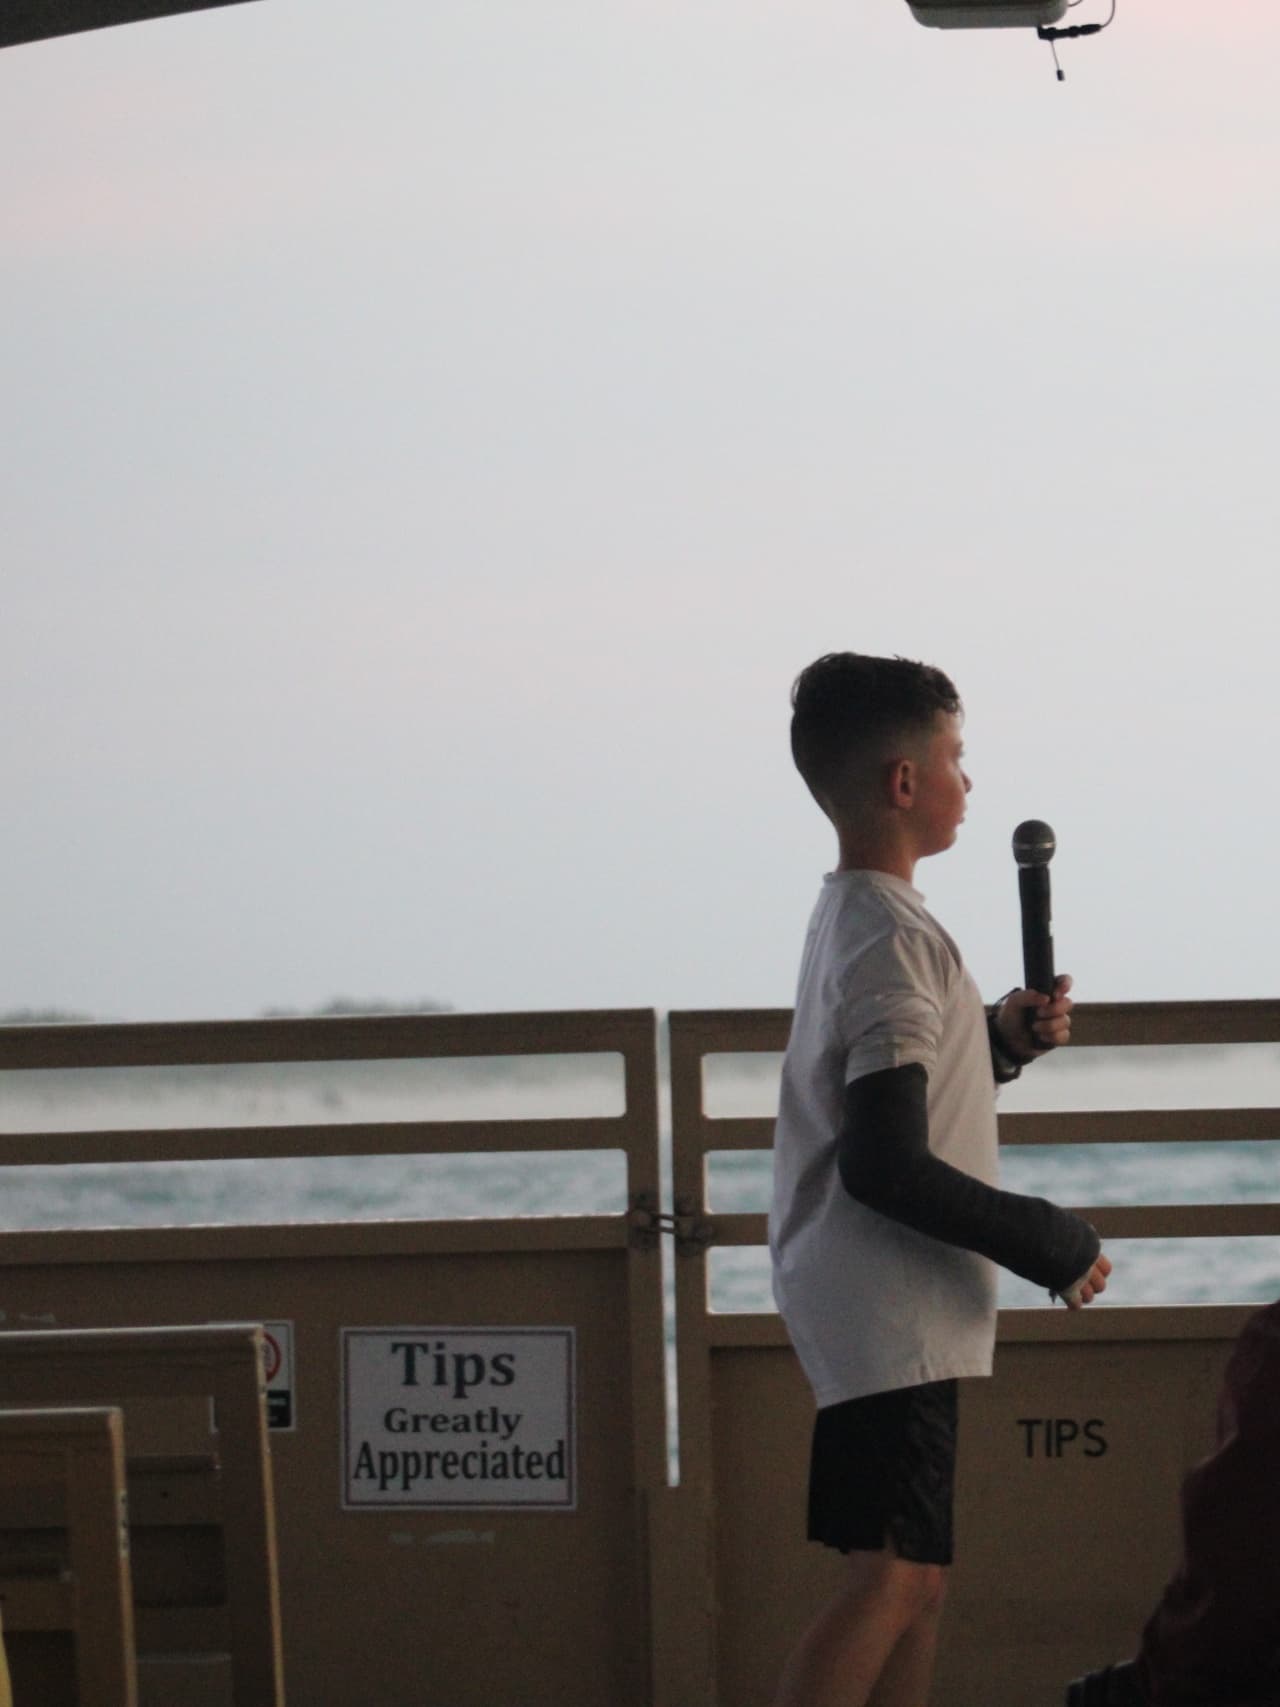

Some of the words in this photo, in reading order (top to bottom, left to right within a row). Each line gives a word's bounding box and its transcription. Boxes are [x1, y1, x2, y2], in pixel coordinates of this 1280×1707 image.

[391, 1341, 516, 1399] Tips
[383, 1406, 523, 1440] Greatly
[1016, 1418, 1108, 1458] TIPS
[352, 1440, 567, 1491] Appreciated
